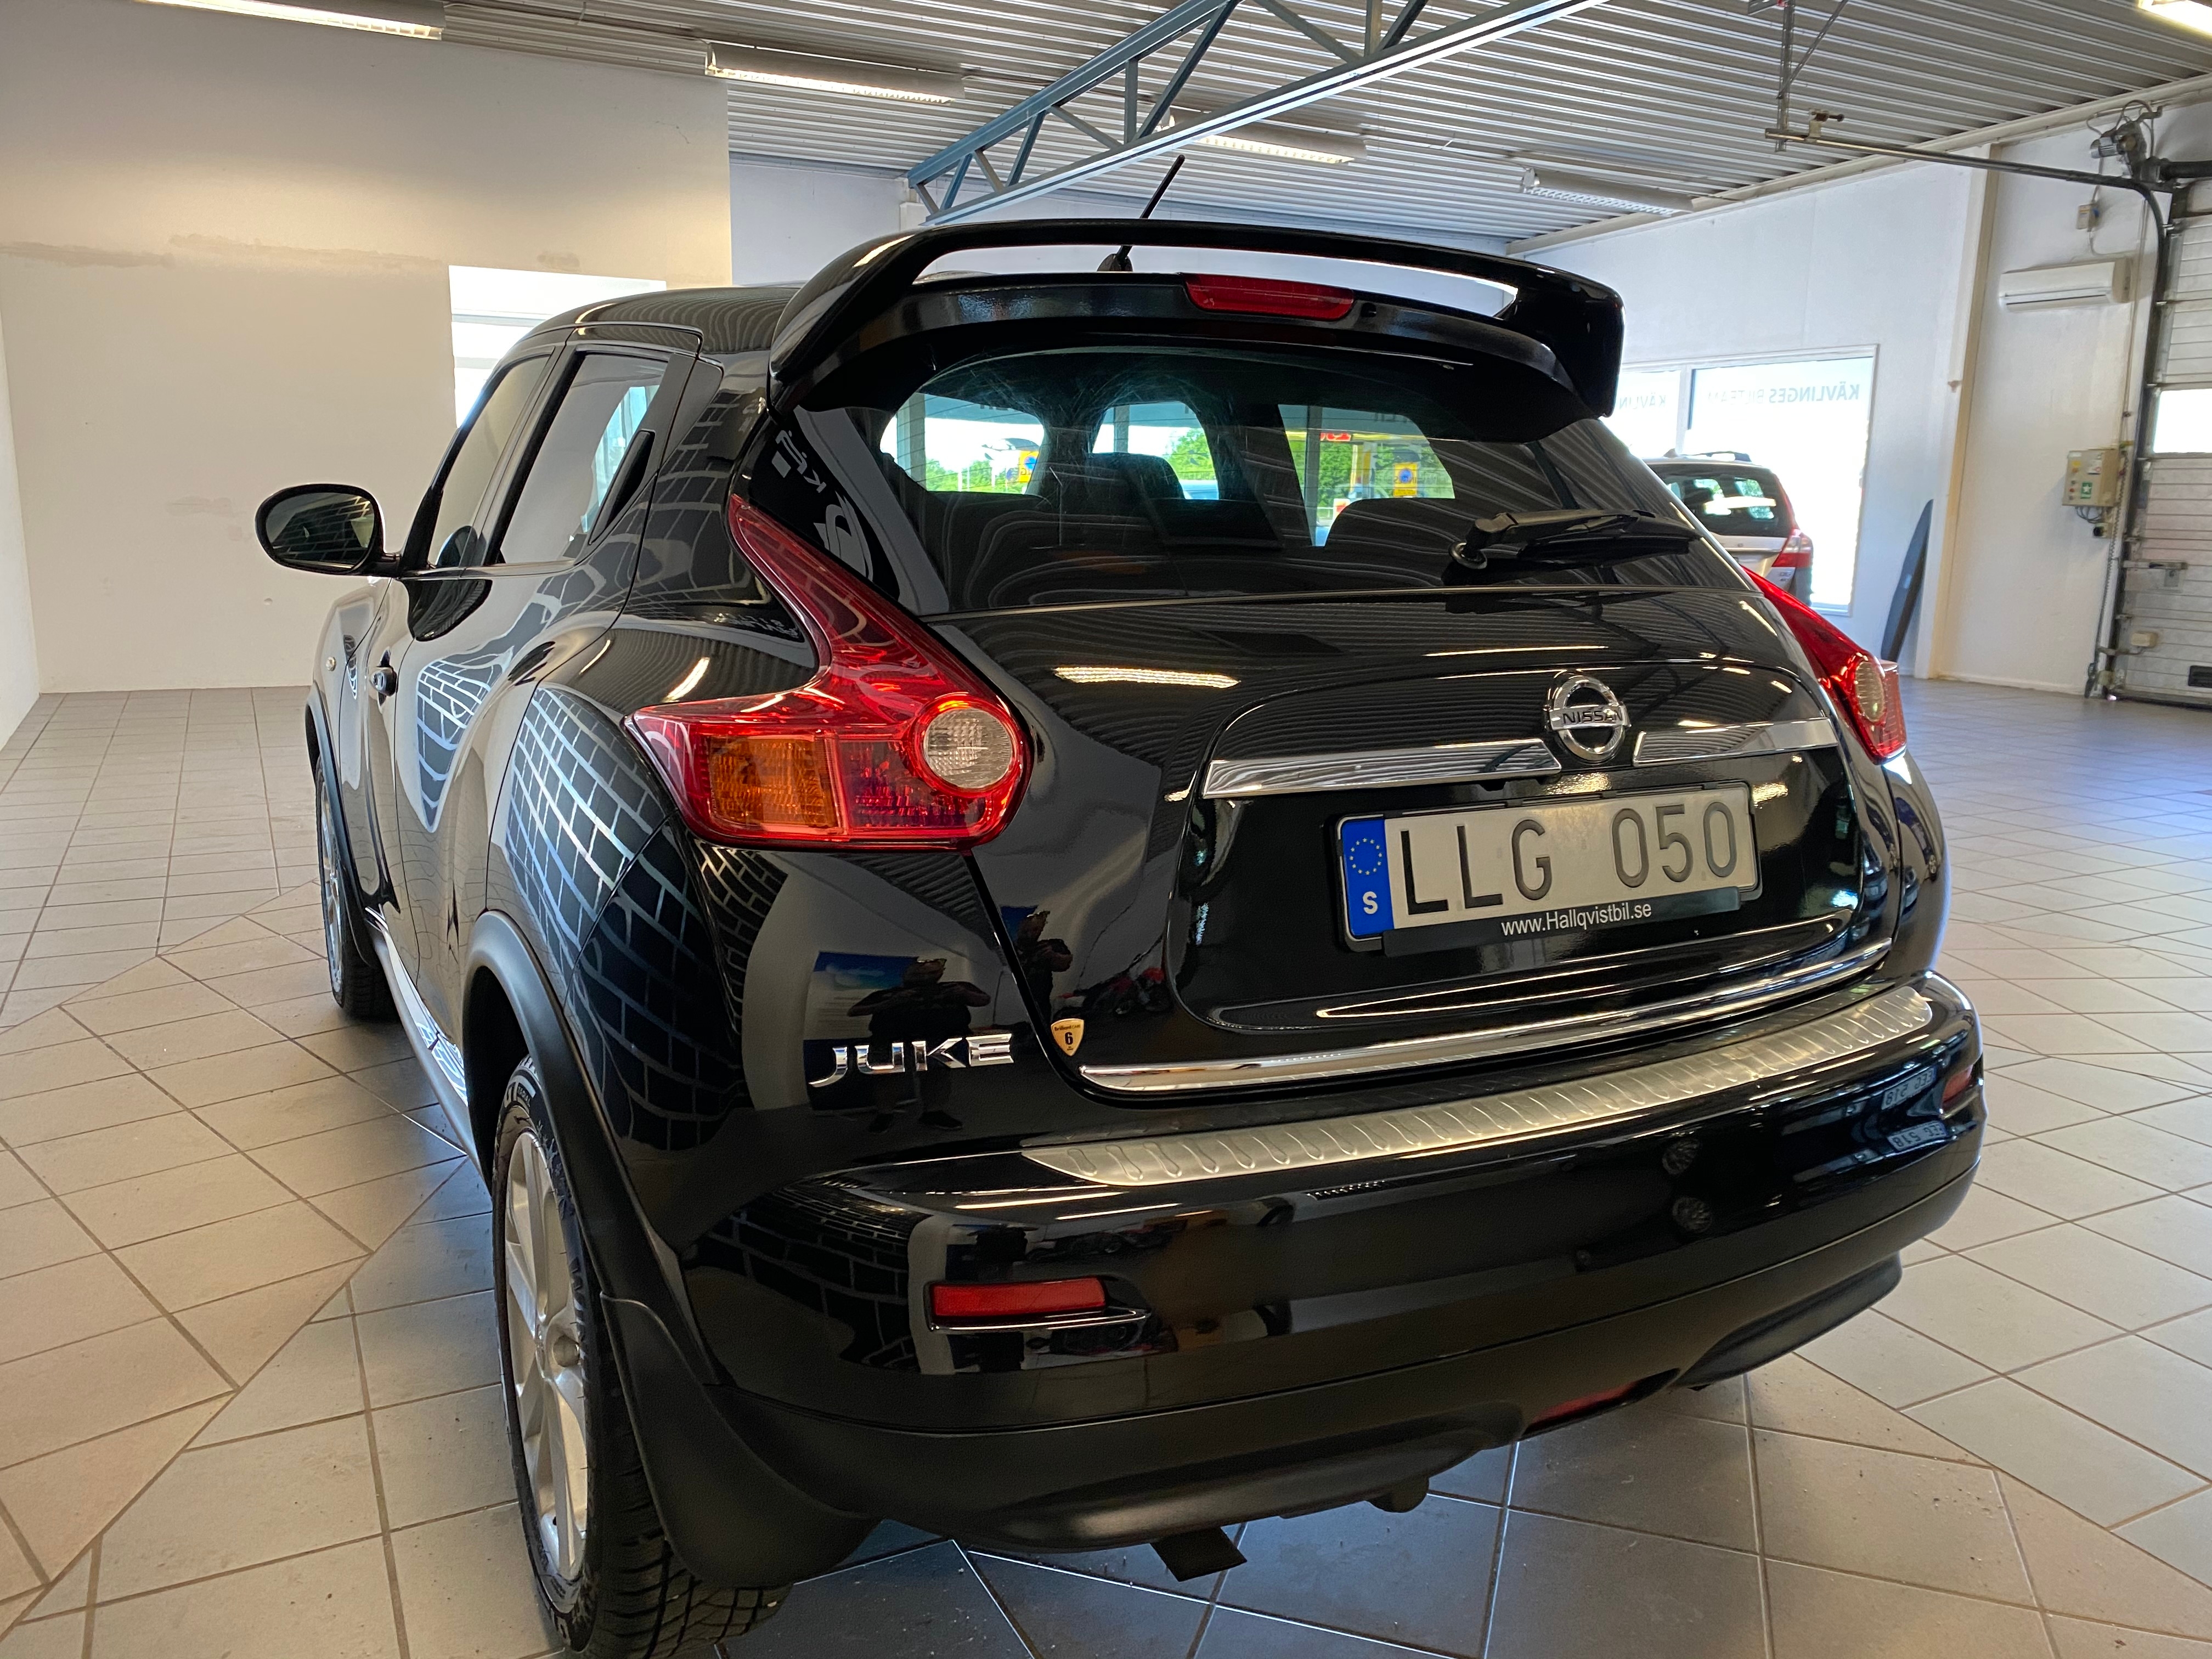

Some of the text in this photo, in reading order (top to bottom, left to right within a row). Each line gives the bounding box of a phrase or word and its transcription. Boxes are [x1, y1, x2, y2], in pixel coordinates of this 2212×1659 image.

[1562, 710, 1623, 724] NISSAN
[1401, 802, 1737, 915] LLG 050
[1363, 891, 1378, 915] S
[1501, 902, 1652, 936] www.Hallqvistbil.se
[1065, 1032, 1073, 1045] 6
[808, 1033, 1014, 1087] JUKE
